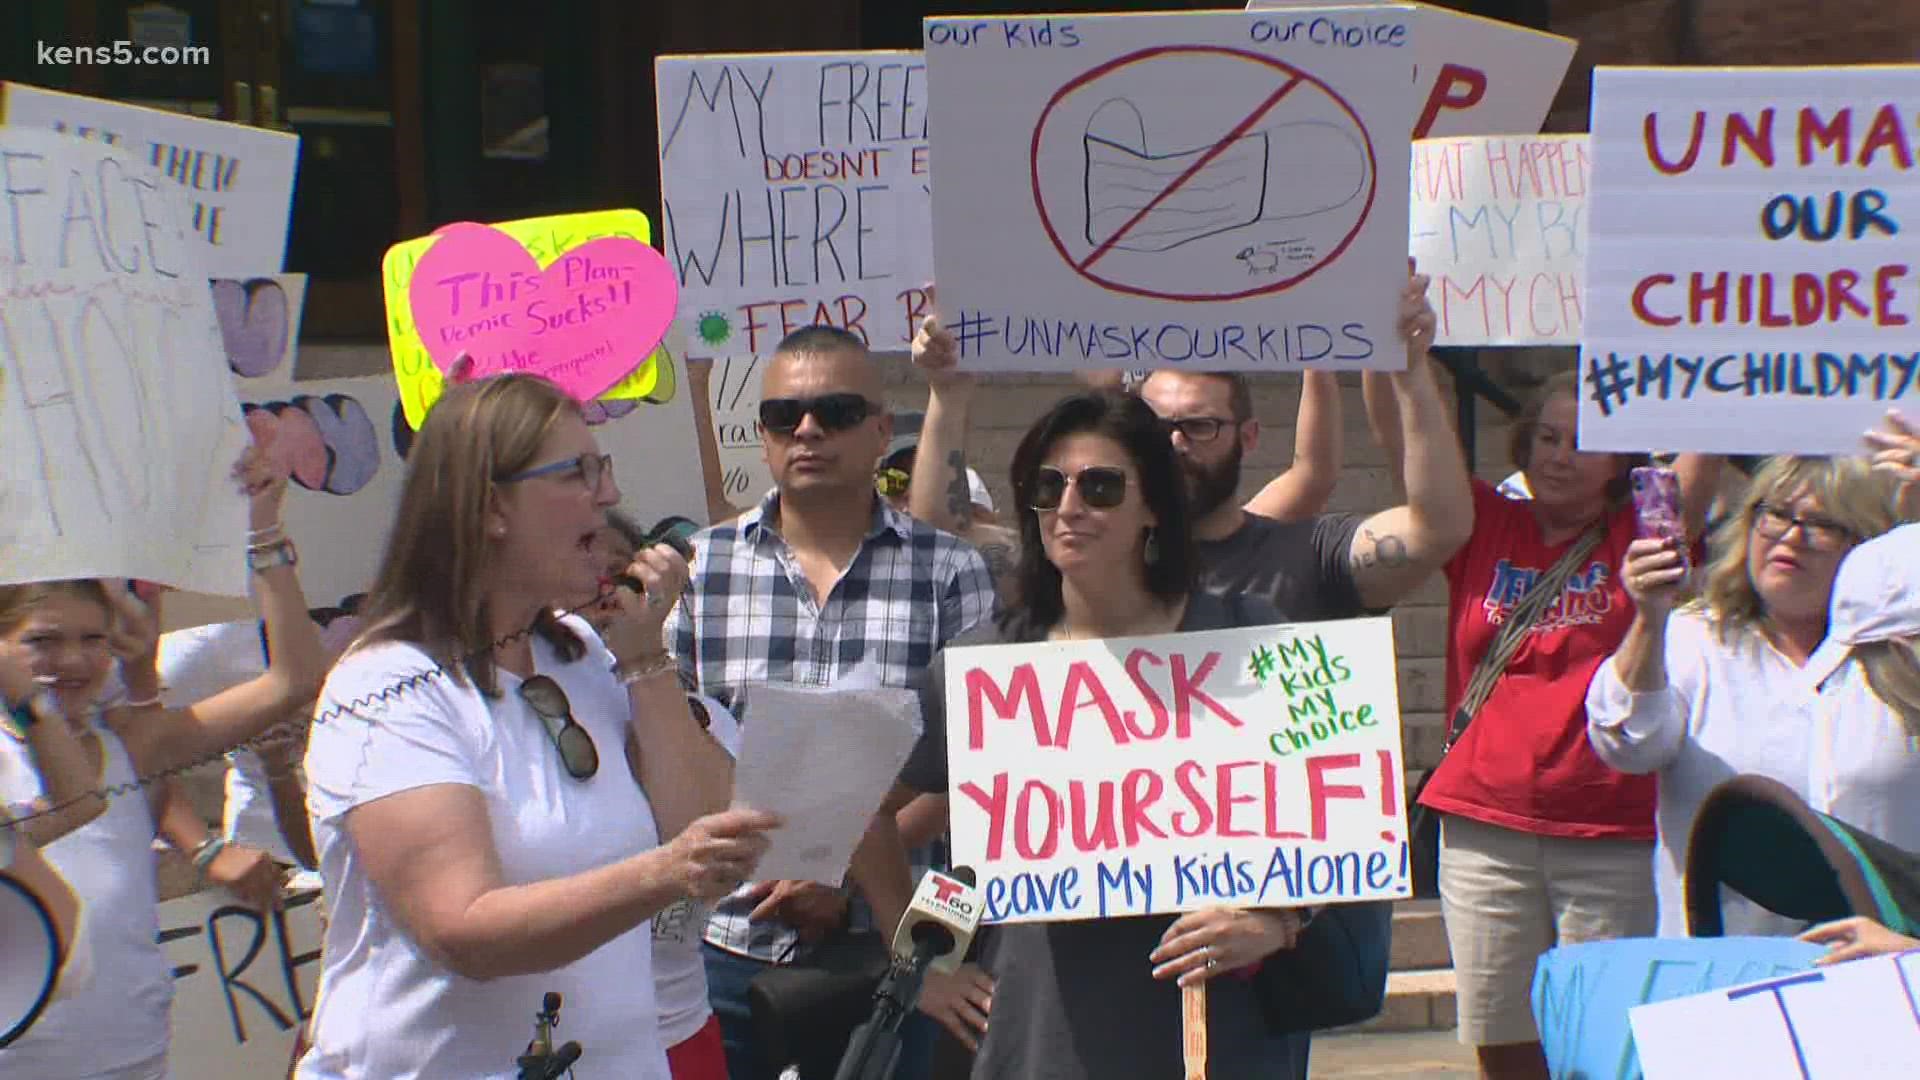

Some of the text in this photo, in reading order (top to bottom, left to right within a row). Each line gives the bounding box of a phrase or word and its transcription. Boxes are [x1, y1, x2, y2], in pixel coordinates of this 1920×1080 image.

[661, 61, 928, 161] MY FREE
[1643, 103, 1920, 176] UNMA
[664, 183, 893, 288] WHERE
[1449, 203, 1521, 264] MY
[1761, 188, 1899, 242] OUR
[436, 271, 541, 317] This
[1631, 264, 1920, 328] CHILDRE
[945, 310, 1374, 363] #UNMASKOURKIDS
[1585, 350, 1920, 418] #MYCHILDMY
[964, 647, 1246, 751] MASK
[958, 750, 1397, 860] YOURSELF!
[980, 866, 1080, 922] eave
